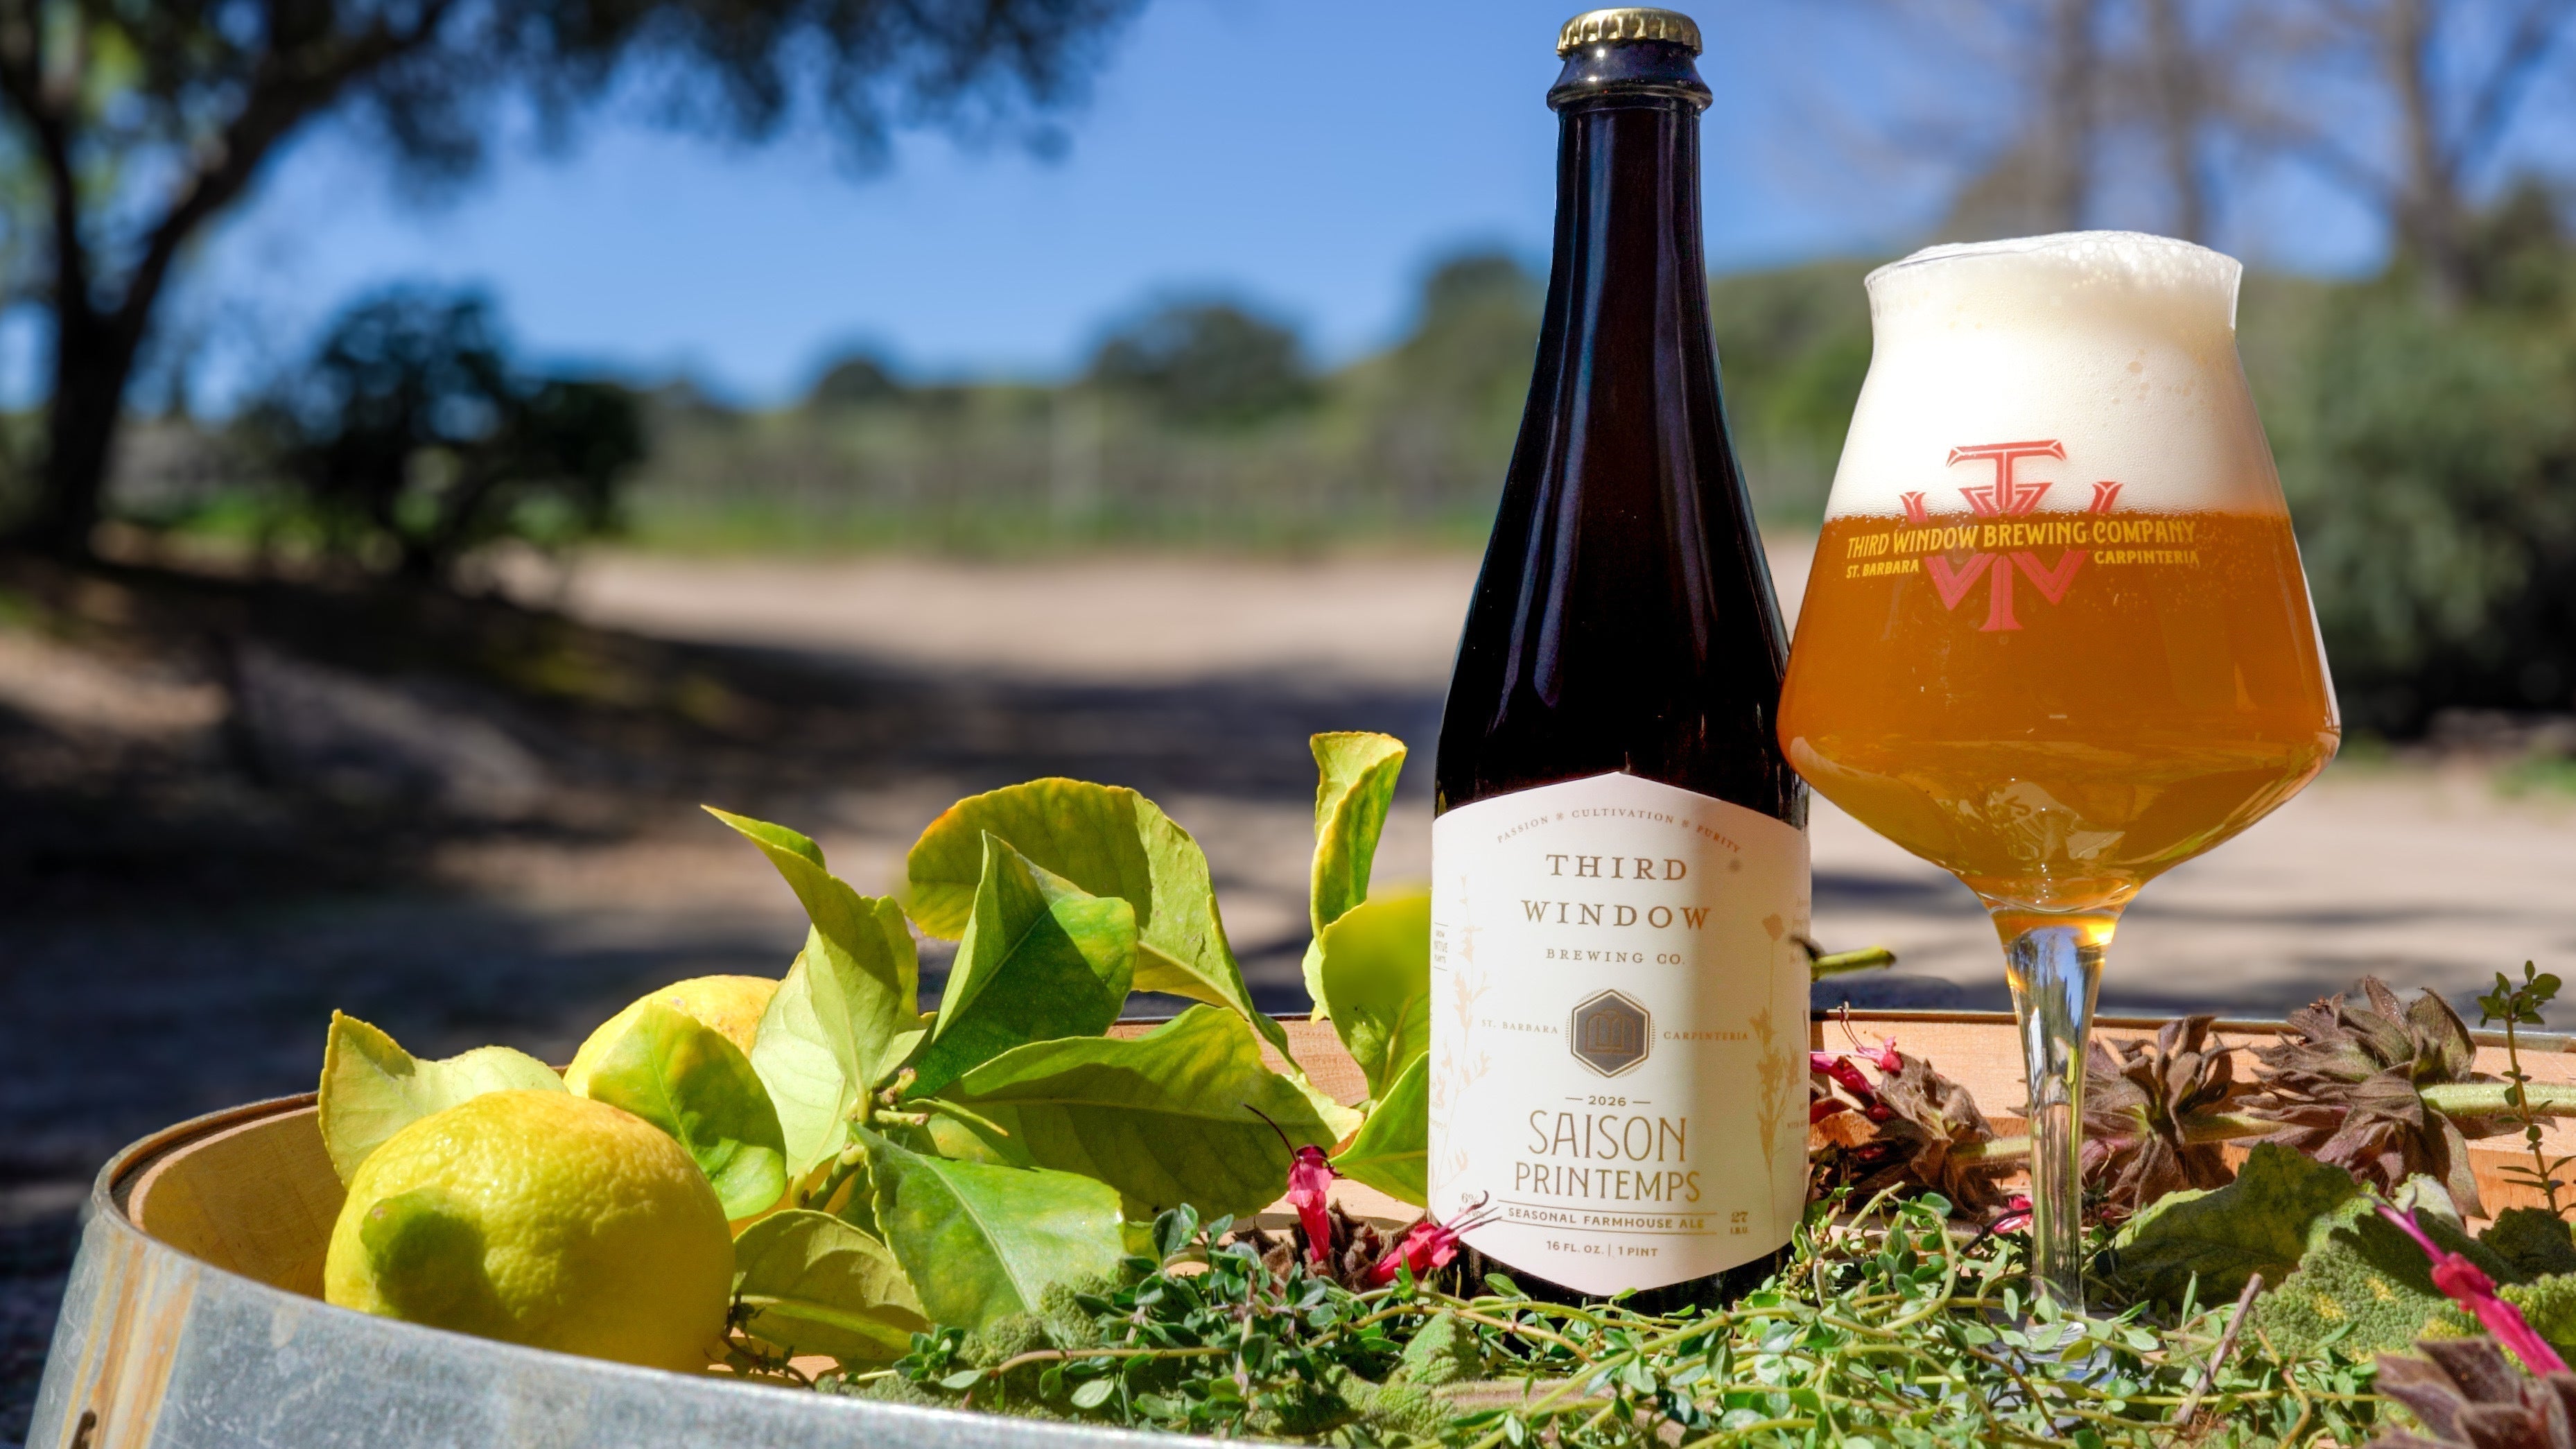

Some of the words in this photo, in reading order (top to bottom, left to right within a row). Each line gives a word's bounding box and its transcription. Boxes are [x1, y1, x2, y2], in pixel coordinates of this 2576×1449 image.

[1847, 533, 1889, 559] THIRD
[1893, 525, 1979, 553] WINDOW
[1983, 521, 2085, 547] BREWING
[2093, 519, 2197, 544] COMPANY
[2094, 550, 2199, 564] CARPINTERIA
[1846, 565, 1861, 579] ST.
[1862, 559, 1920, 577] BARBARA
[1497, 816, 1549, 843] PASSION
[1572, 808, 1674, 824] CULTIVATION
[1697, 825, 1741, 853] PURITY
[1546, 854, 1687, 881] THIRD
[1521, 900, 1712, 930] WINDOW
[1546, 948, 1644, 964] BREWING
[1657, 953, 1685, 965] CO.
[1481, 1019, 1496, 1027] ST.
[1502, 1022, 1558, 1034] BARBARA
[1664, 1031, 1749, 1041] CARPINTERIA
[1588, 1095, 1627, 1107] 2026
[1528, 1110, 1687, 1163] SAISON
[1515, 1161, 1702, 1203] PRINTEMPS
[1508, 1207, 1576, 1224] SEASONAL
[1583, 1215, 1673, 1229] FARMHOUSE
[1680, 1219, 1705, 1229] ALE
[1731, 1211, 1748, 1223] 27
[1546, 1240, 1560, 1251] 16
[1563, 1243, 1581, 1253] FL.
[1584, 1244, 1604, 1255] OZ.
[1619, 1246, 1624, 1256] 1
[1628, 1247, 1659, 1257] PINT
